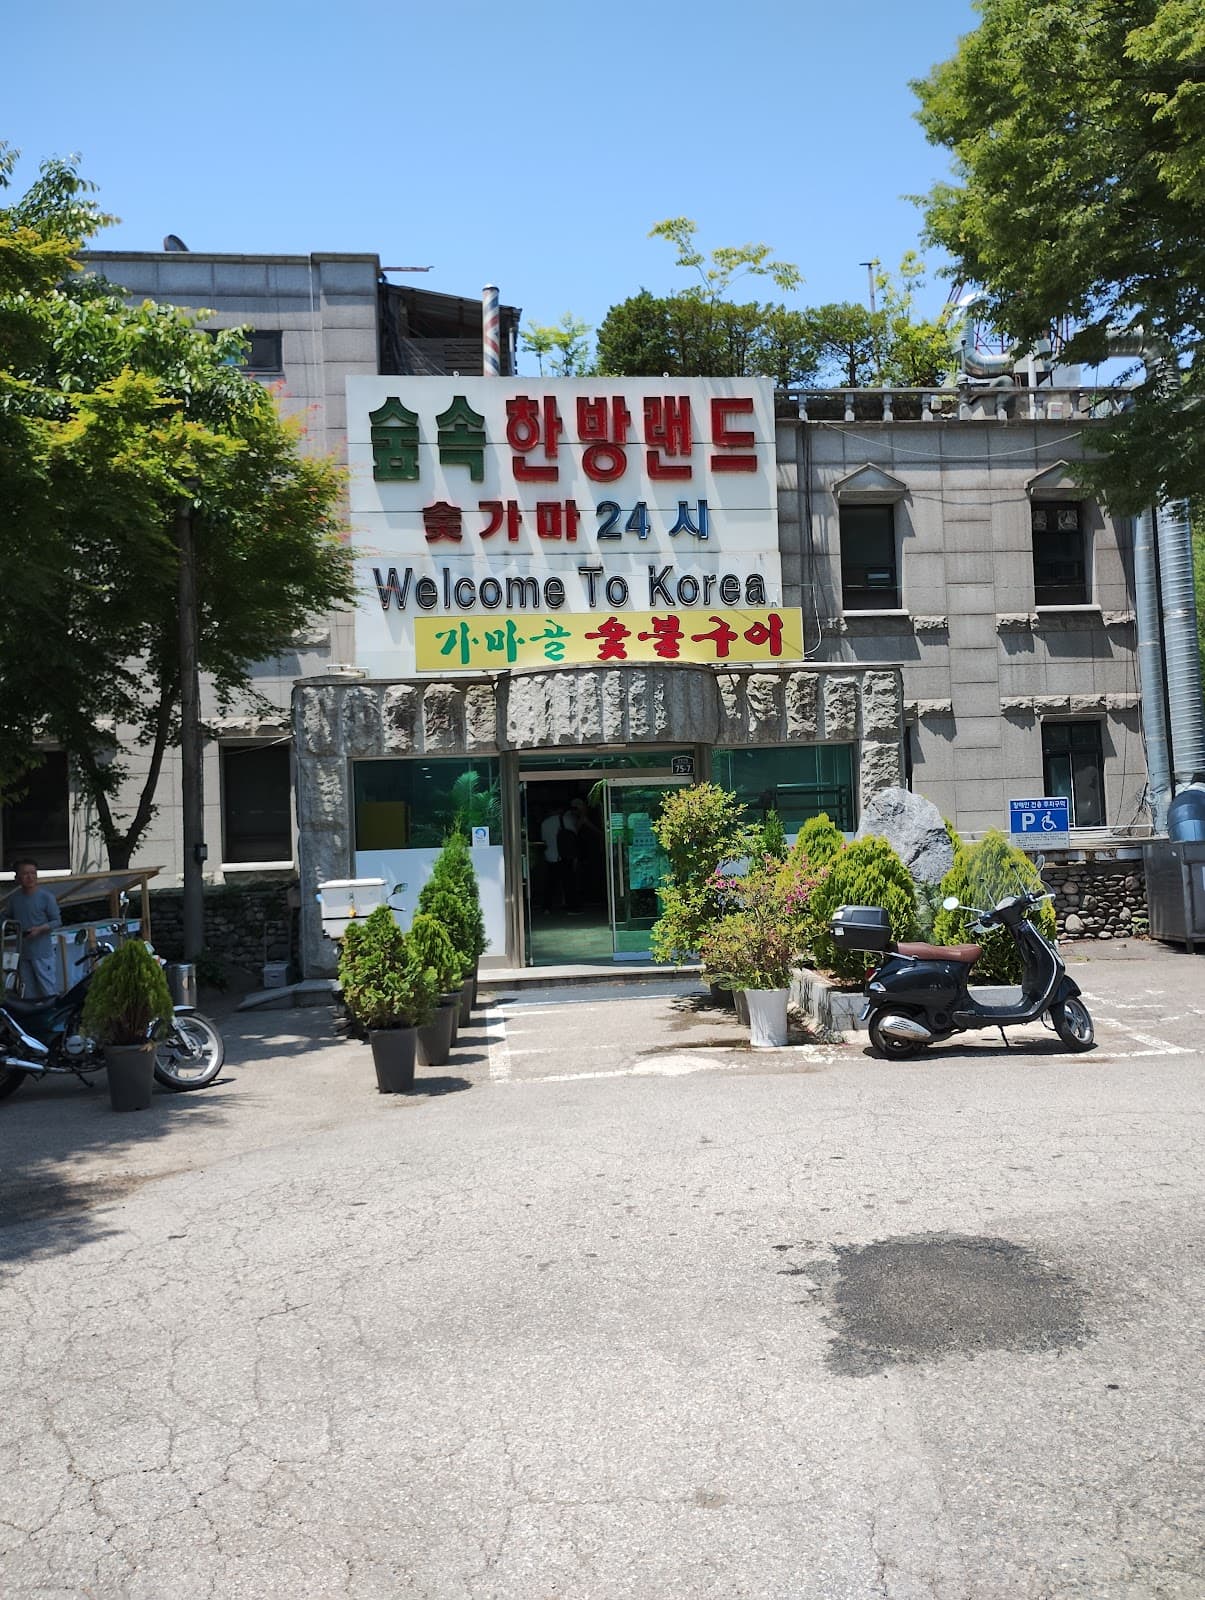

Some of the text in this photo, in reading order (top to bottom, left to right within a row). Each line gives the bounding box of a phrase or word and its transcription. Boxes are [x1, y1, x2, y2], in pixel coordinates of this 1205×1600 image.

[369, 395, 758, 483] 숲속 한방랜드
[422, 500, 580, 543] 숯가마
[373, 565, 766, 610] Welcome To Korea
[584, 613, 784, 661] 숯불구이
[1022, 812, 1036, 831] P
